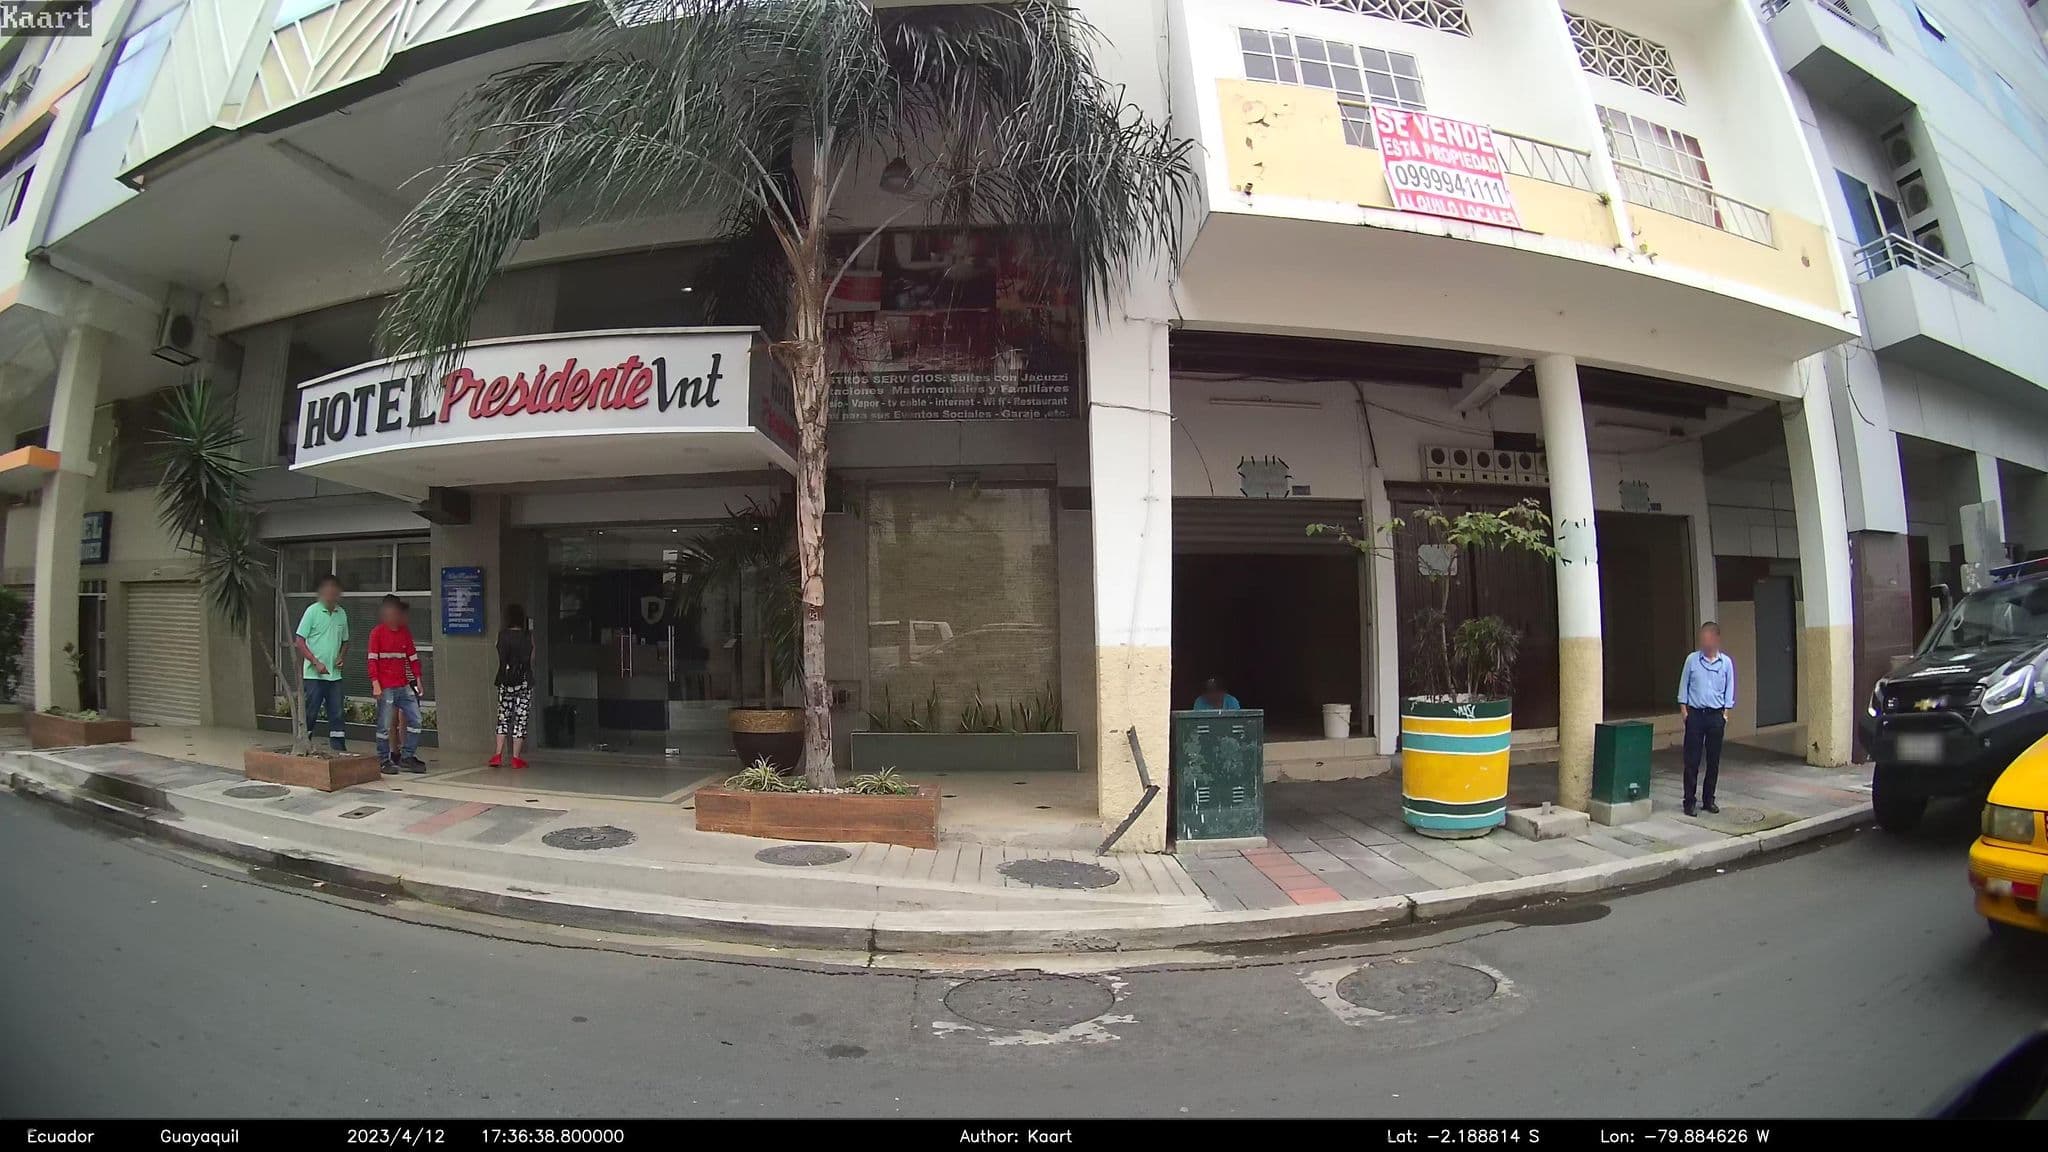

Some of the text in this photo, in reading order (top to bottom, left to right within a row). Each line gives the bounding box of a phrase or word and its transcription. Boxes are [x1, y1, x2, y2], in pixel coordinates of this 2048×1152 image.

[1375, 108, 1493, 153] SE VENDE
[1382, 138, 1499, 173] ESTA PROPIEDAD
[1395, 164, 1505, 205] 0999941111
[1000, 384, 1069, 394] Familiares
[1021, 373, 1068, 382] Jacuzzi
[303, 373, 436, 449] HOTEL
[438, 355, 653, 422] Presidente
[852, 399, 879, 409] Vapor
[1013, 397, 1068, 406] Restaurant
[942, 409, 991, 418] Sociales
